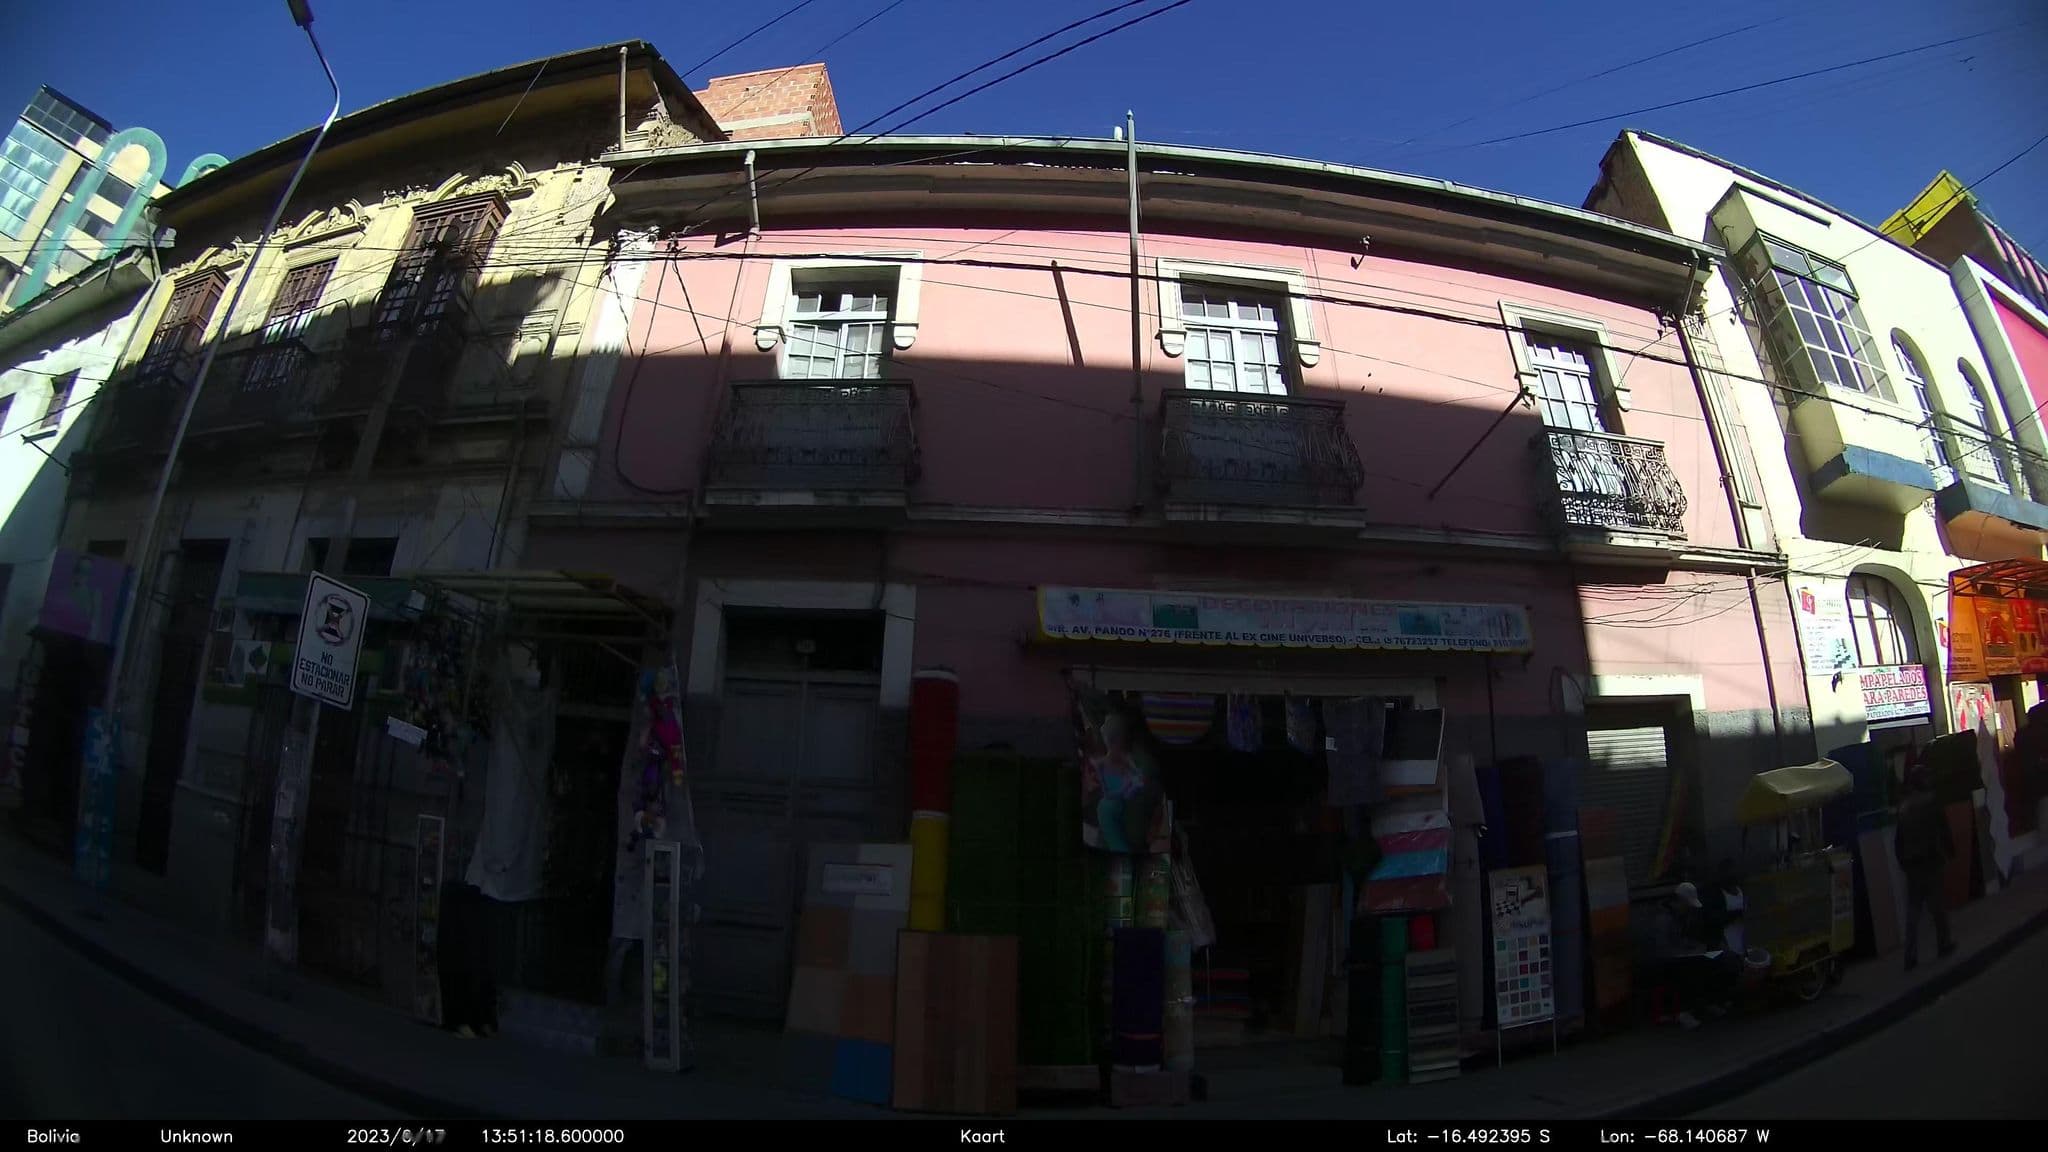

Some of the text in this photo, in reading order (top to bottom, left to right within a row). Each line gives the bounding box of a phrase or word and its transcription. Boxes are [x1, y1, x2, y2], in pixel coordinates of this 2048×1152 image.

[1095, 626, 1135, 636] PANDO
[1225, 631, 1240, 641] AL
[1243, 632, 1256, 642] EX
[1260, 633, 1287, 643] CINE
[321, 652, 333, 666] NO
[299, 658, 350, 686] ESTACIONAR
[1859, 670, 1923, 689] MPAPELADOS
[301, 673, 345, 698] NO PARAR
[1863, 689, 1885, 705] ARA
